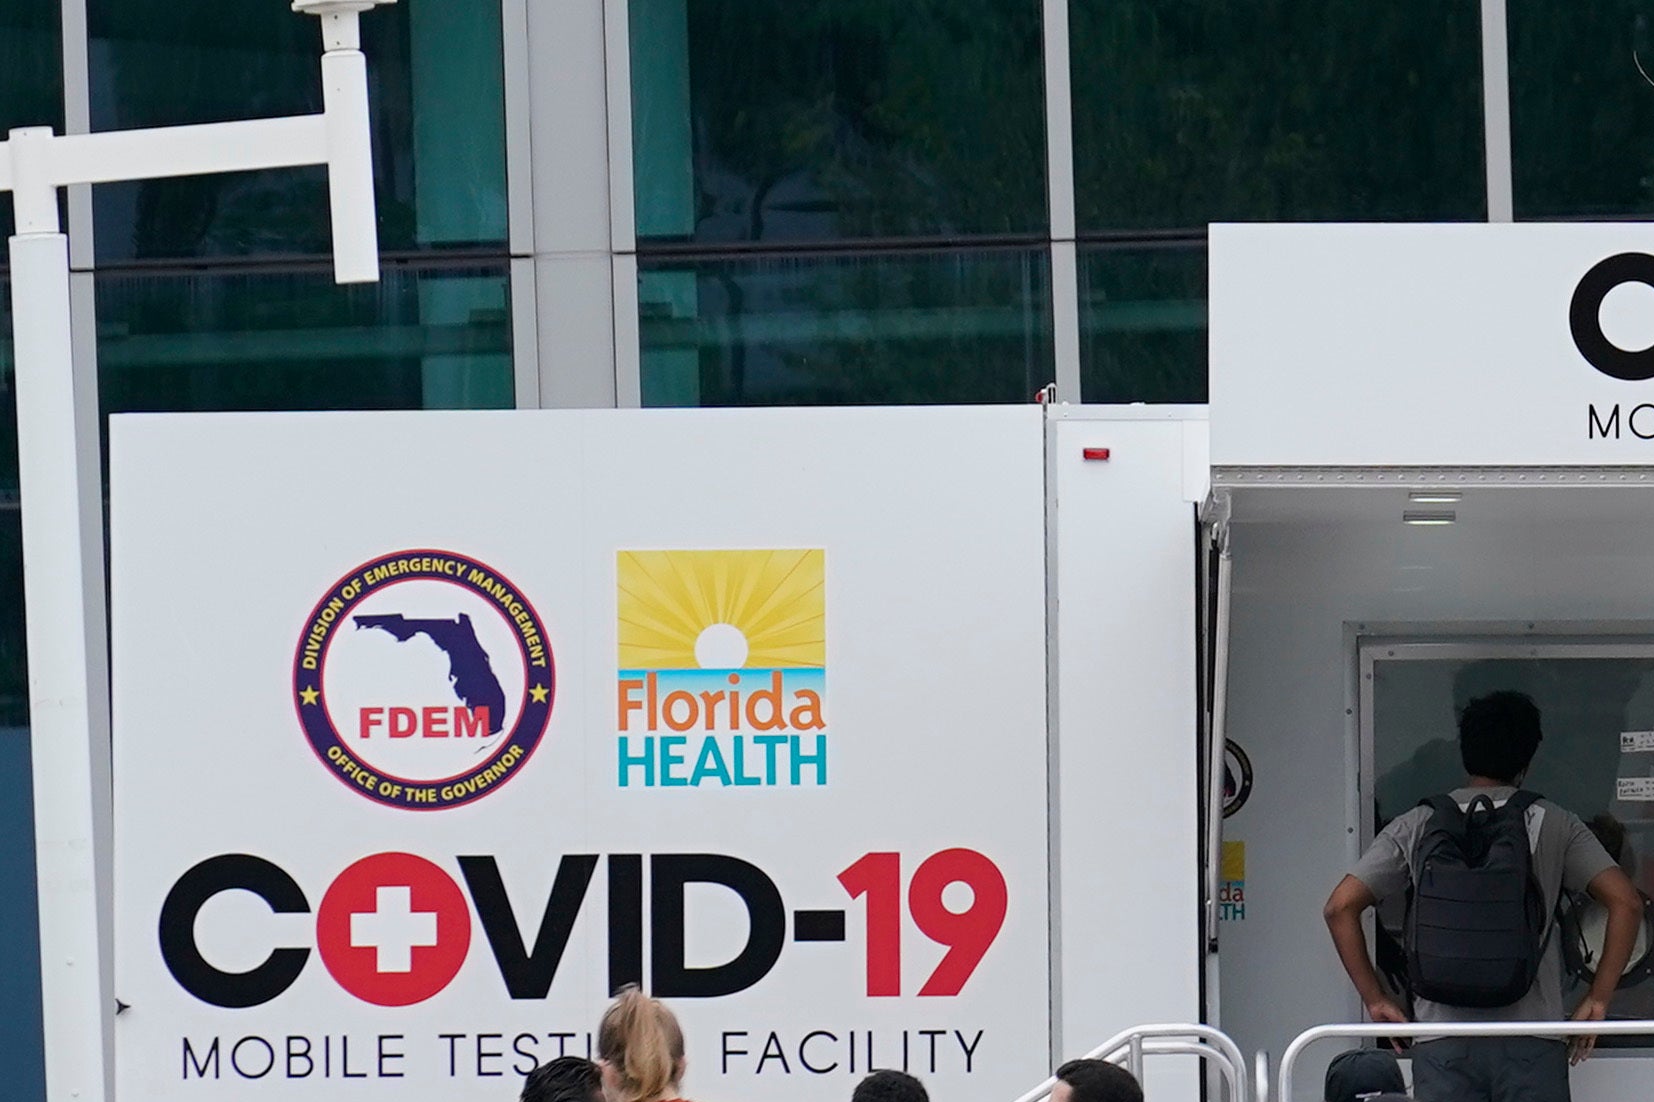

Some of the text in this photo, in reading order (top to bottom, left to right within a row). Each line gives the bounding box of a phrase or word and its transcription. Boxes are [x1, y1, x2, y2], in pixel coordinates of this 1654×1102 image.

[302, 557, 546, 670] DIVISION OF EMERGENCY MANAGEMENT
[359, 705, 491, 739] FDEM
[618, 672, 827, 731] Florida
[327, 744, 524, 803] OFFICE OF THE GOVERNOR
[618, 734, 828, 788] HEALTH
[158, 847, 1009, 1008] COVID-19
[182, 1030, 985, 1079] MOBILE TESTI FACILITY
